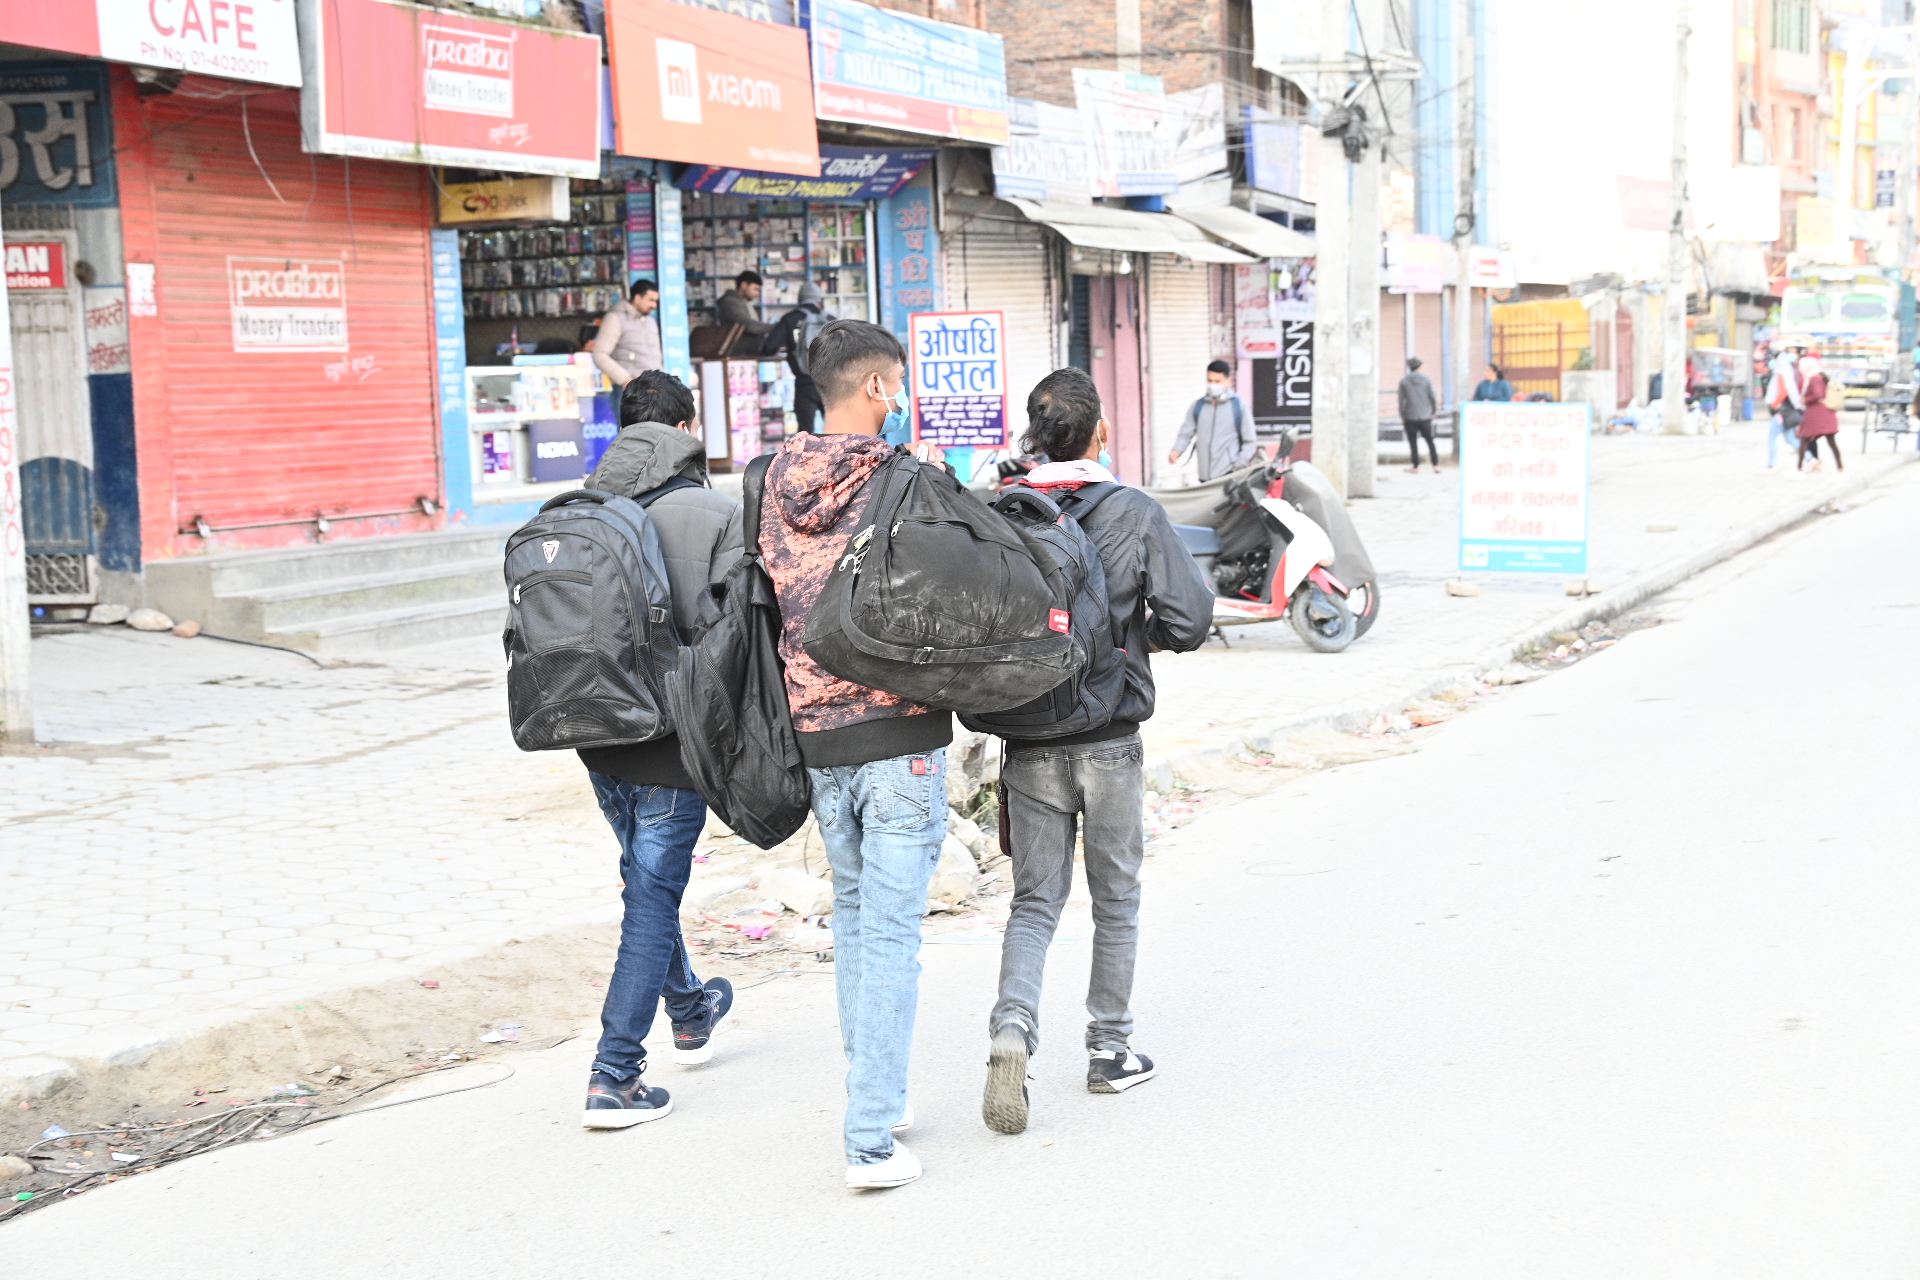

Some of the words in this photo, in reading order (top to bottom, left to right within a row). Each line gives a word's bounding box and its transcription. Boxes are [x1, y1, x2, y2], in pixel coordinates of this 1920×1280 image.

[149, 0, 258, 50] CAFE
[141, 42, 159, 59] Ph
[191, 50, 269, 76] 01-4020017
[706, 72, 782, 112] xiaomi
[5, 246, 49, 273] AN
[7, 274, 52, 287] ation
[239, 312, 282, 342] Money
[288, 312, 341, 337] Transfer
[918, 317, 997, 357] औषधि
[920, 360, 997, 393] पसल
[1285, 320, 1312, 407] ANSUI
[1503, 411, 1585, 427] COVID-19
[1481, 433, 1524, 452] (PCR
[1529, 433, 1570, 452] Test)
[1491, 458, 1513, 478] को
[1518, 458, 1557, 479] लागि
[1490, 514, 1544, 537] गरिन्छ
